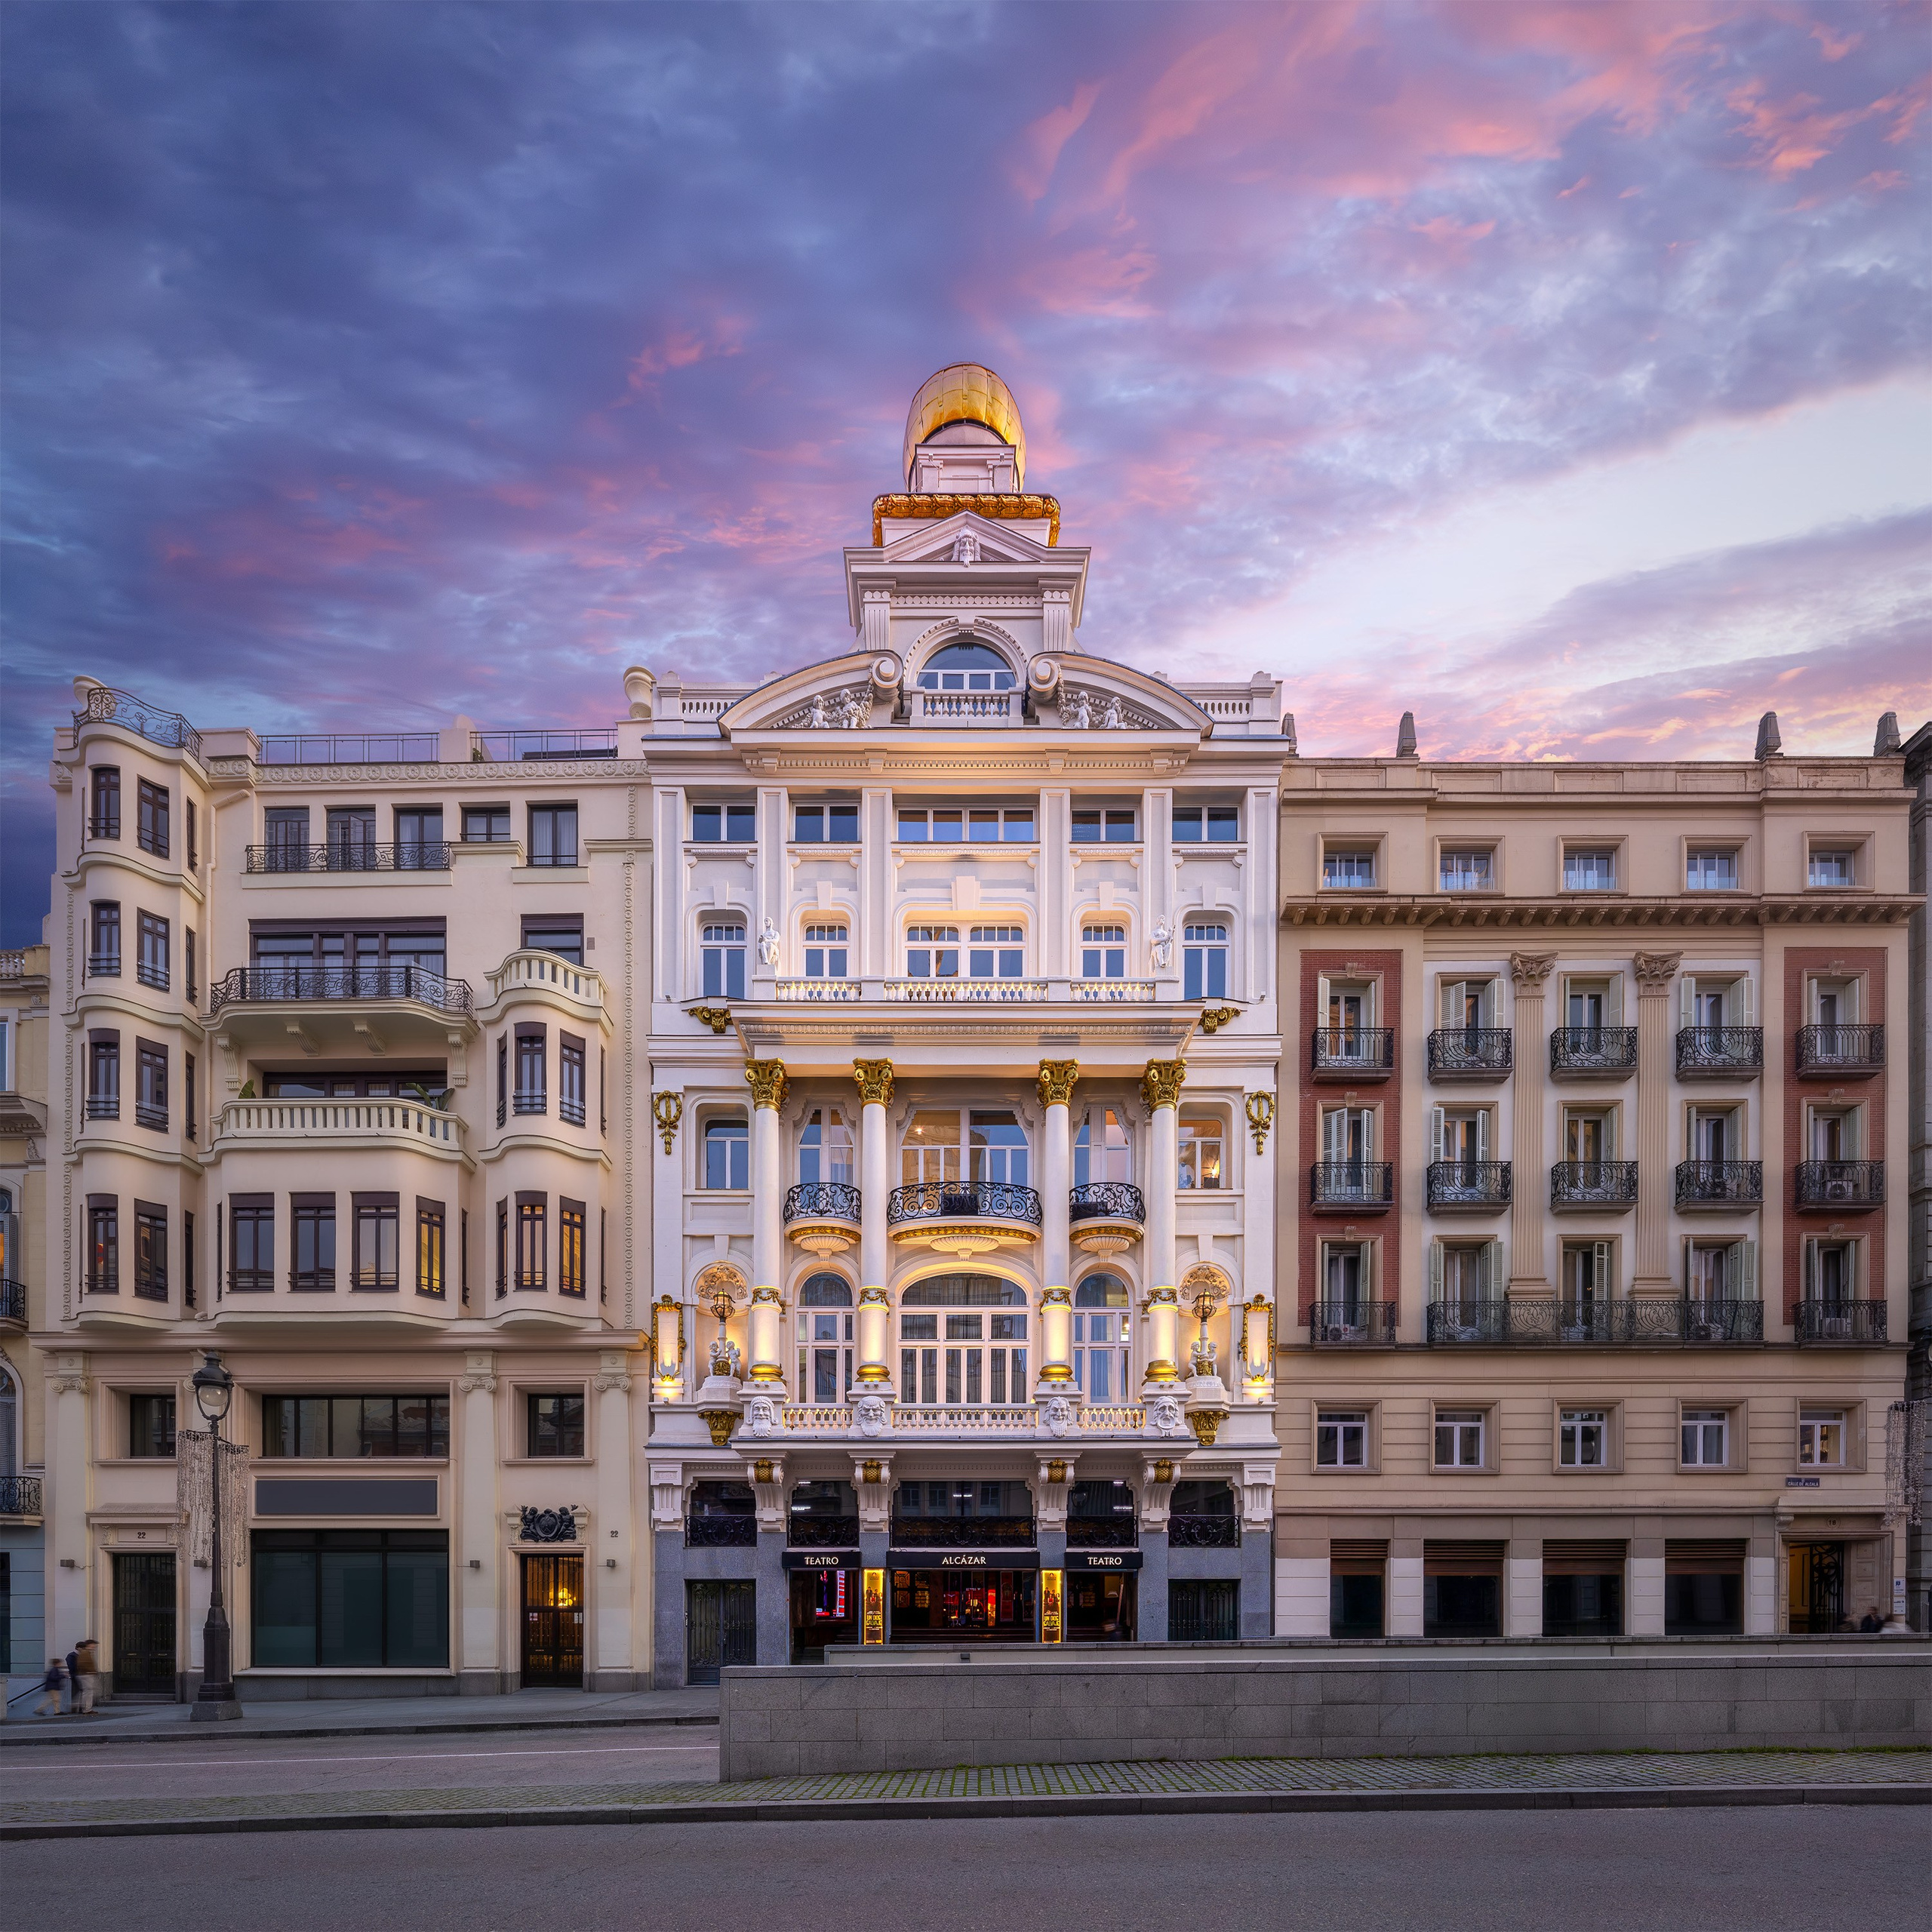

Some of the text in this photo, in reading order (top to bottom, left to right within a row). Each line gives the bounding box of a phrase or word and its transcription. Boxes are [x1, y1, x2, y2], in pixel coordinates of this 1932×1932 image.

[611, 1530, 619, 1538] 22
[804, 1556, 839, 1565] TEATRO
[941, 1554, 987, 1564] ALCÁZAR
[1087, 1556, 1122, 1565] TEATRO
